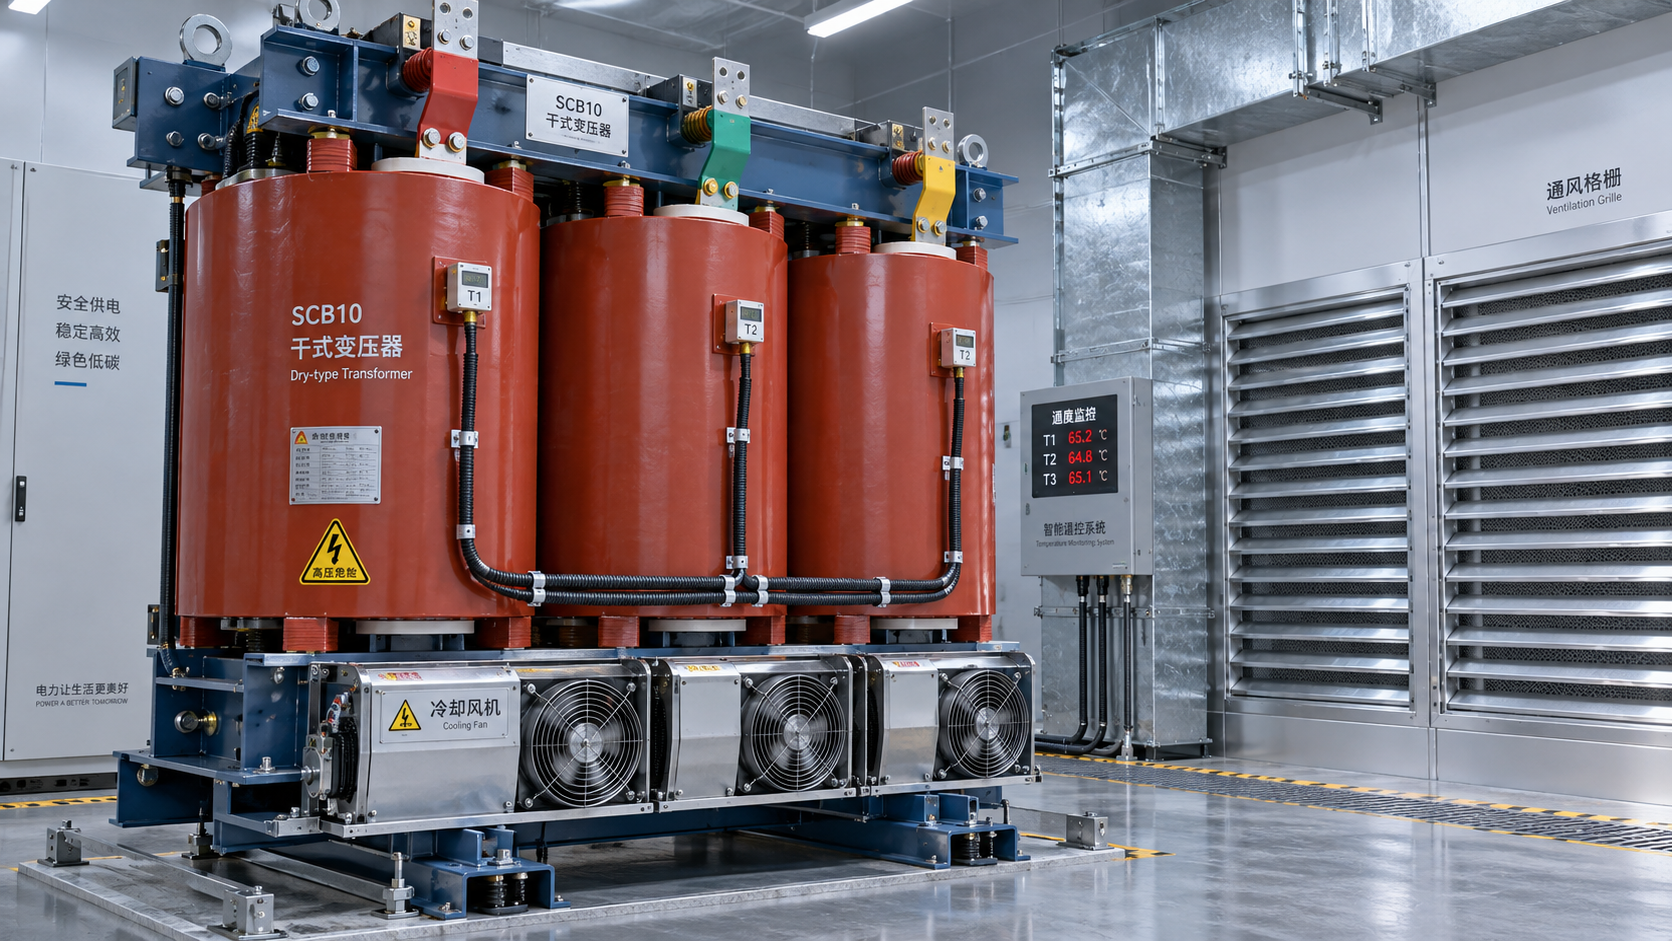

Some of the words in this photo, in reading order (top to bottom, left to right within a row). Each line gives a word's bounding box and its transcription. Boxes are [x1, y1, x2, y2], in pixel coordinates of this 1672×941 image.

[556, 95, 602, 117] SCB10
[546, 112, 611, 139] 干式变压器
[1547, 167, 1622, 201] 通风格栅
[1546, 199, 1595, 215] Ventilation
[1597, 192, 1622, 205] Grille
[56, 294, 121, 314] 安全供电
[467, 290, 481, 303] T1
[291, 303, 363, 326] SCB10
[55, 322, 121, 343] 稳定高效
[744, 323, 758, 336] T2
[290, 334, 403, 360] 干式变压器
[959, 349, 971, 361] T2
[55, 351, 120, 371] 绿色低碳
[290, 369, 339, 384] Dry-type
[341, 367, 413, 380] Transformer
[1043, 434, 1056, 447] T1
[1068, 429, 1093, 444] 65.2
[1043, 453, 1057, 466] T2
[1068, 449, 1093, 465] 64.8
[1043, 473, 1057, 486] T3
[1068, 470, 1092, 485] 65.1
[430, 698, 501, 718] 冷却风机
[443, 721, 472, 731] Cooling
[473, 720, 488, 729] Fan
